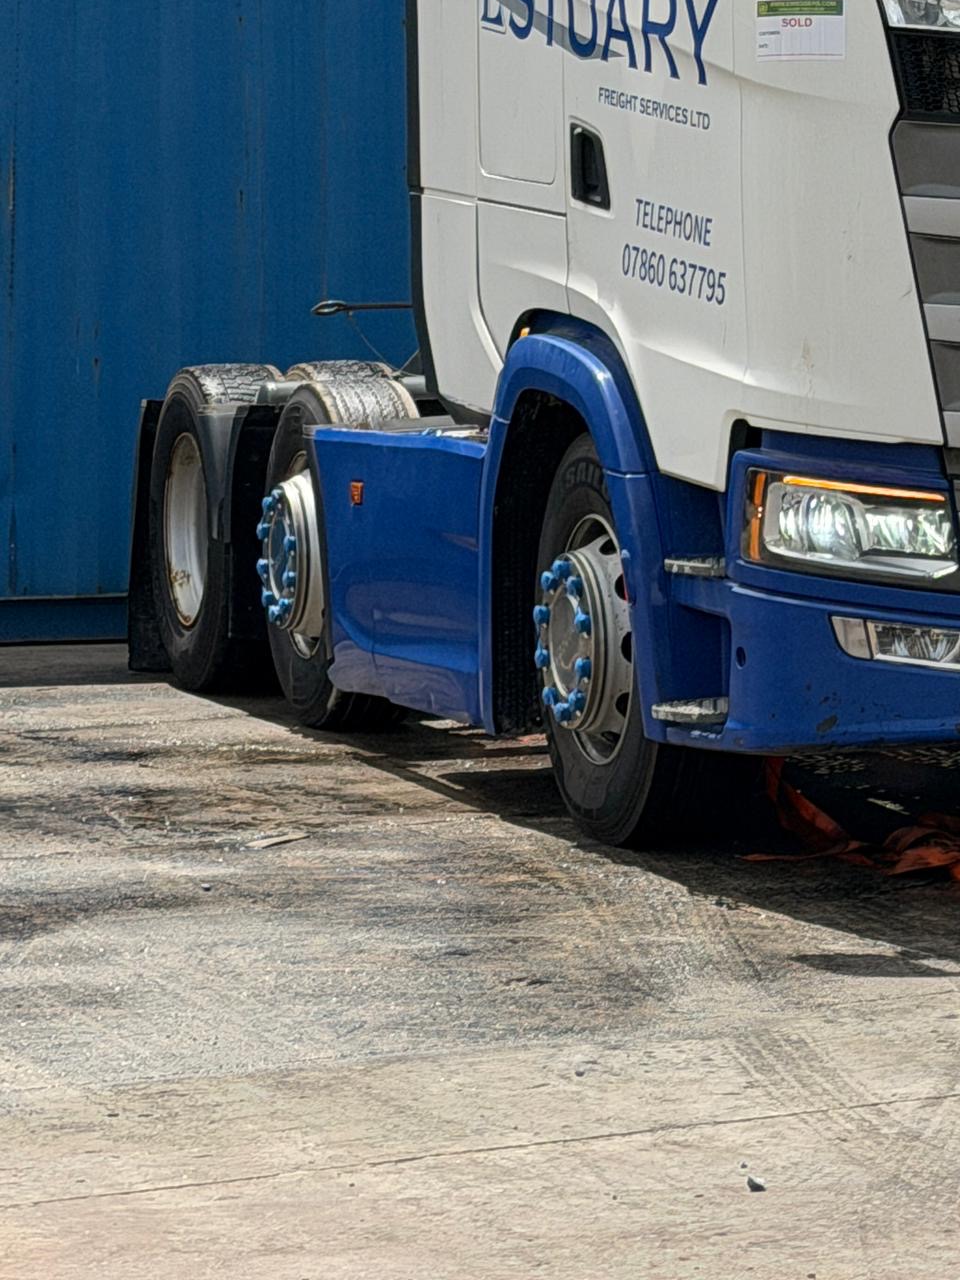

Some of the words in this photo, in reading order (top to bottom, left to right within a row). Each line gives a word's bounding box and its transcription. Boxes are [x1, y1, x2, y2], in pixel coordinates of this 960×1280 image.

[781, 17, 813, 28] SOLD
[598, 86, 639, 113] FREIGHT
[639, 97, 688, 125] SERVICES
[690, 109, 711, 131] LTD
[635, 198, 713, 247] TELEPHONE
[622, 243, 665, 288] 07860
[668, 257, 727, 306] 637795
